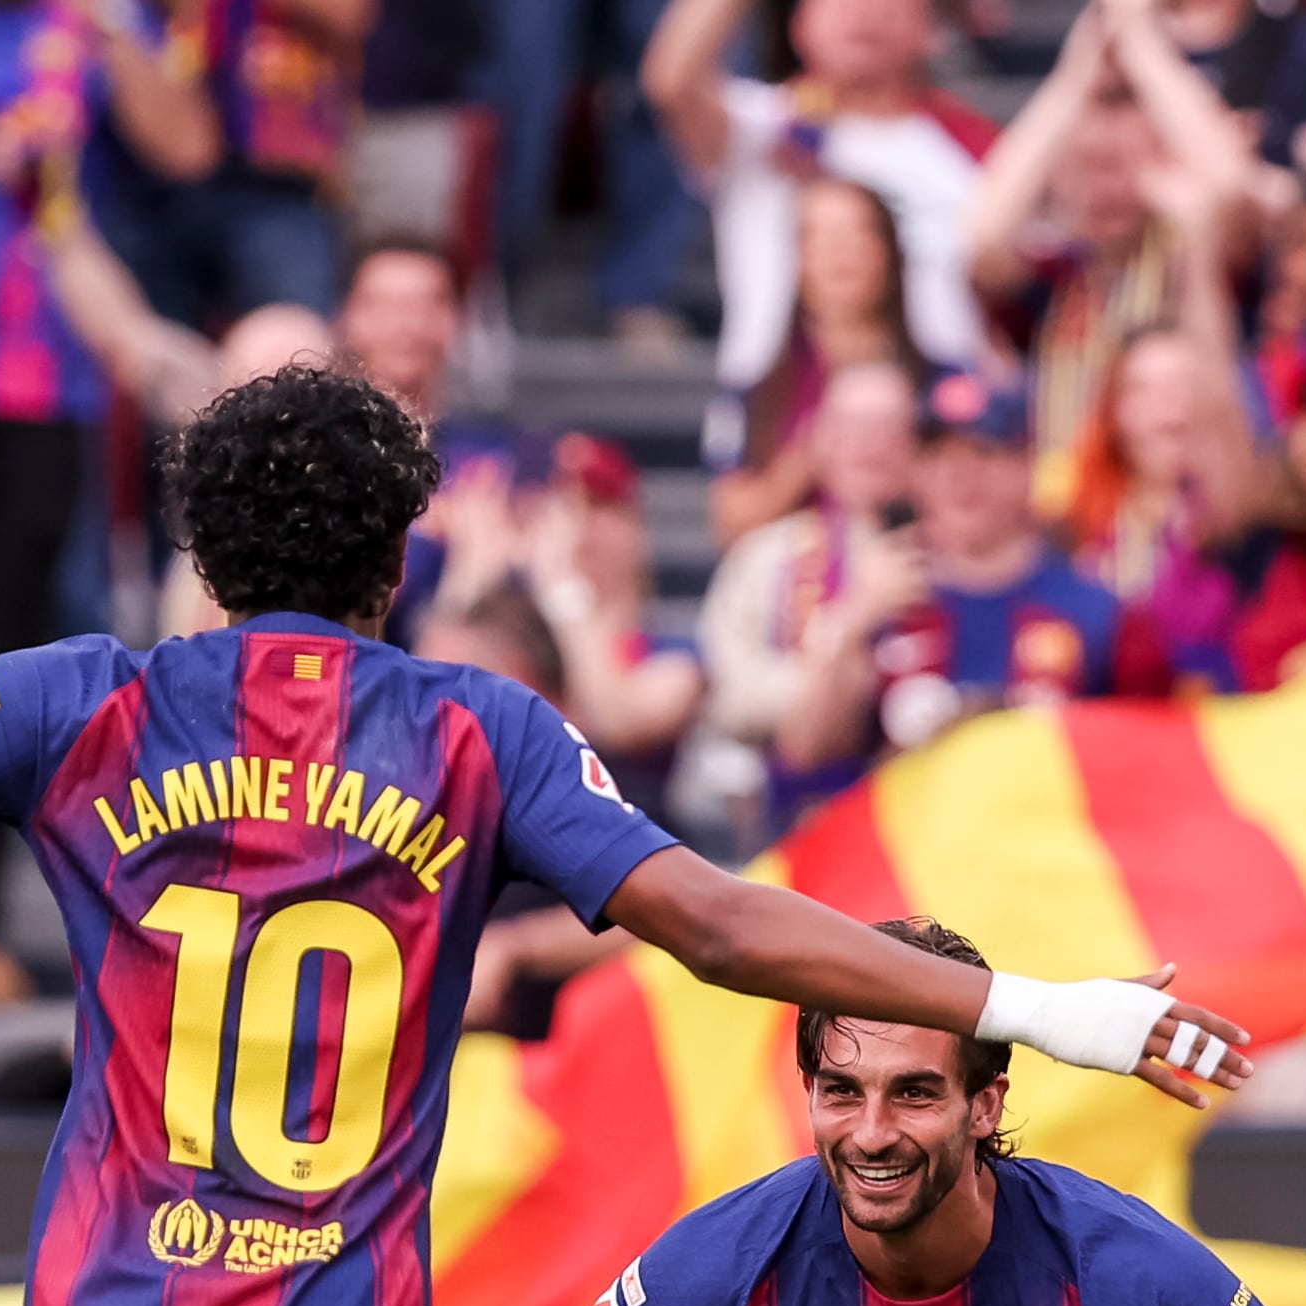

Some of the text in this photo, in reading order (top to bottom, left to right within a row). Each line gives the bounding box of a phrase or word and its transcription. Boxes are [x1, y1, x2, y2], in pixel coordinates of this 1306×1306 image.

[94, 756, 467, 894] LAMINE YAMAL
[138, 883, 404, 1192] 10
[229, 1218, 344, 1248] UNHCR
